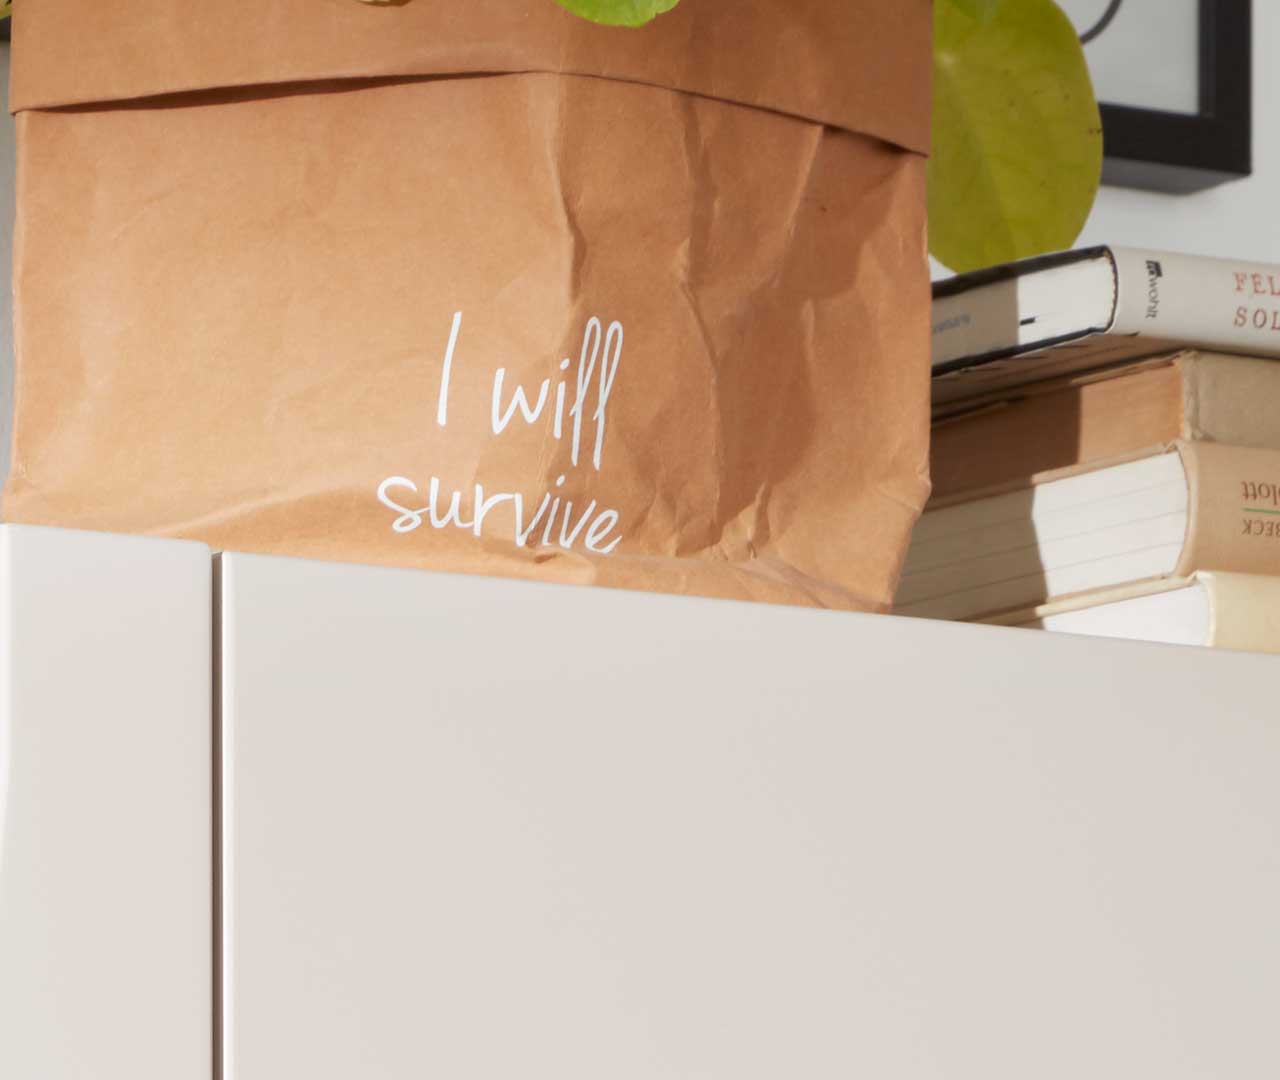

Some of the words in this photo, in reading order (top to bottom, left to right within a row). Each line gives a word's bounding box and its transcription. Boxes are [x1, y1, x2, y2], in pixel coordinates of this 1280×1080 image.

[437, 311, 462, 427] I
[491, 316, 623, 471] will
[376, 474, 622, 554] survive
[1241, 481, 1280, 506] lott
